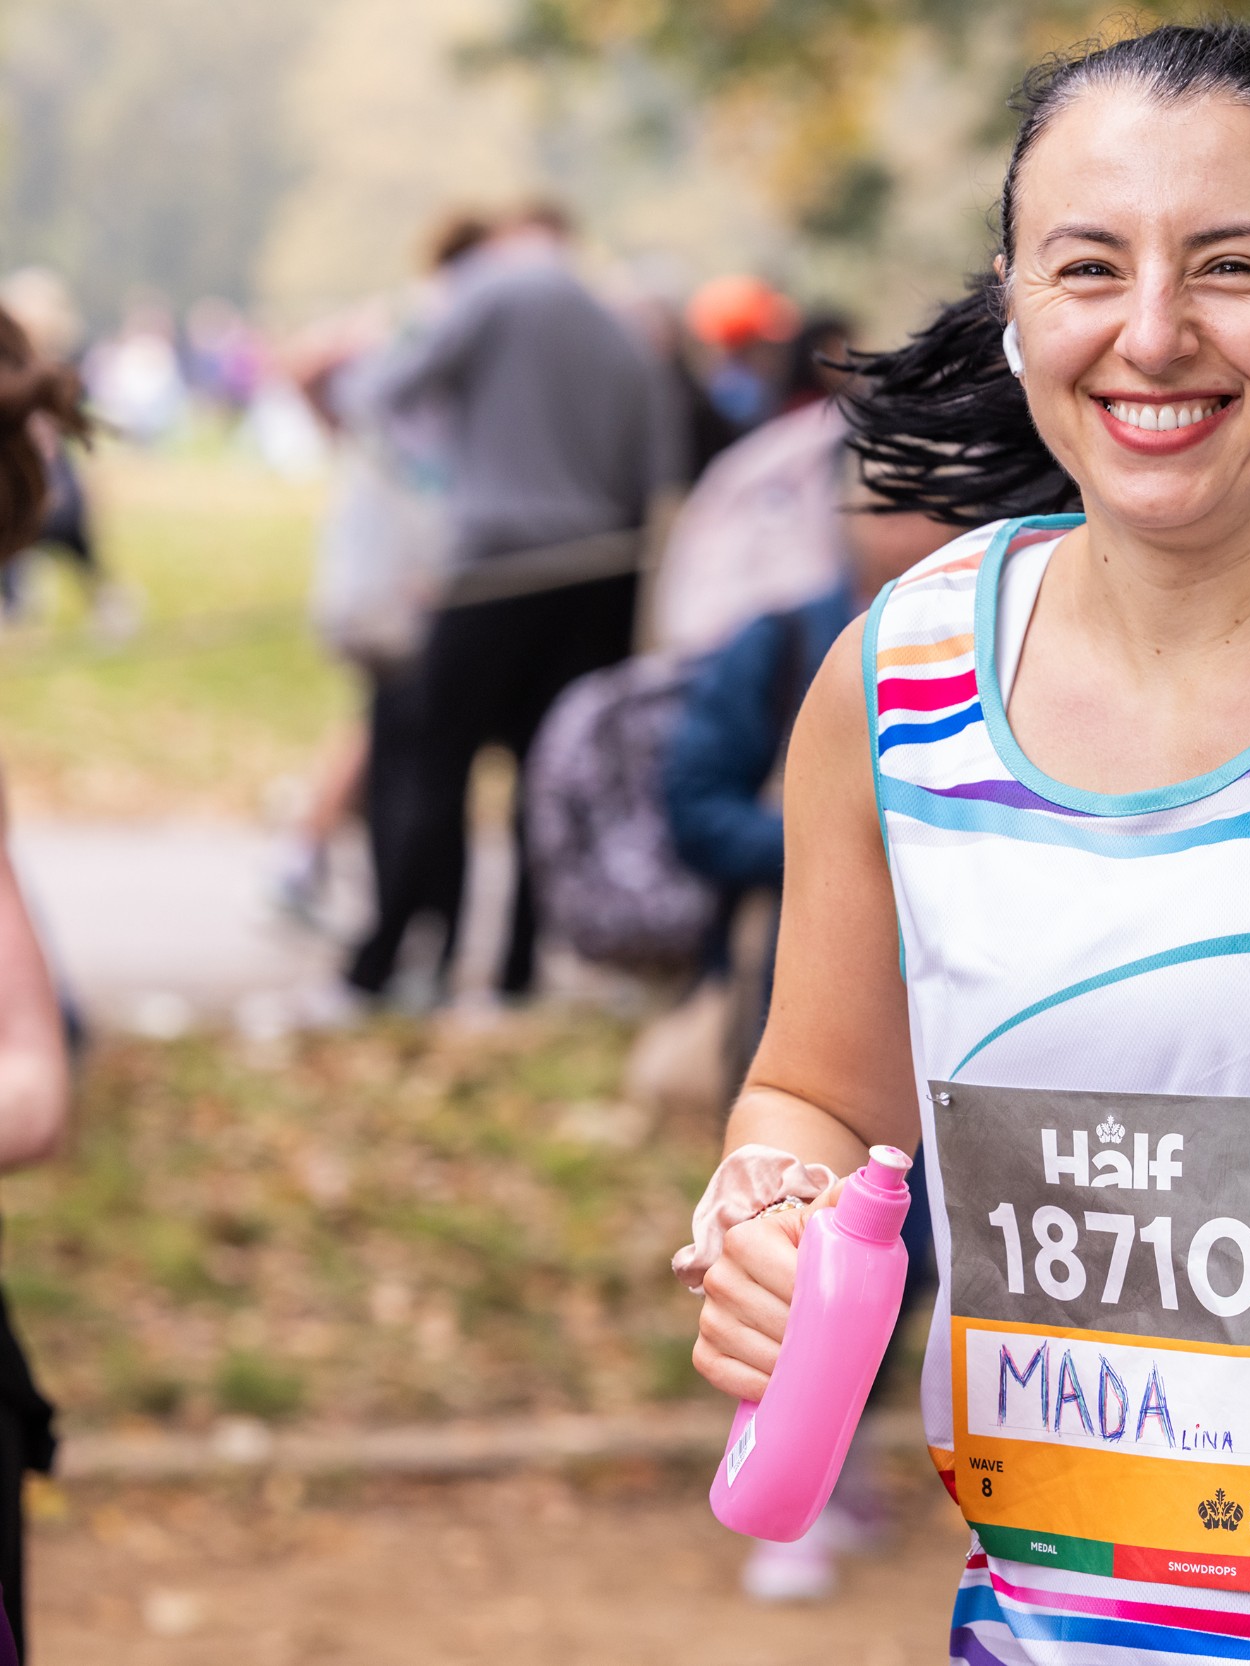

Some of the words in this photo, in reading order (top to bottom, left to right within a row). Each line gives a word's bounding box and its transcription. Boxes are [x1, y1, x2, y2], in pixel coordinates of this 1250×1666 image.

[1041, 1128, 1184, 1191] Half
[969, 1456, 1004, 1473] WAVE
[981, 1477, 993, 1498] 8
[1030, 1542, 1058, 1555] MEDAL
[1168, 1561, 1237, 1577] SNOWDROPS
